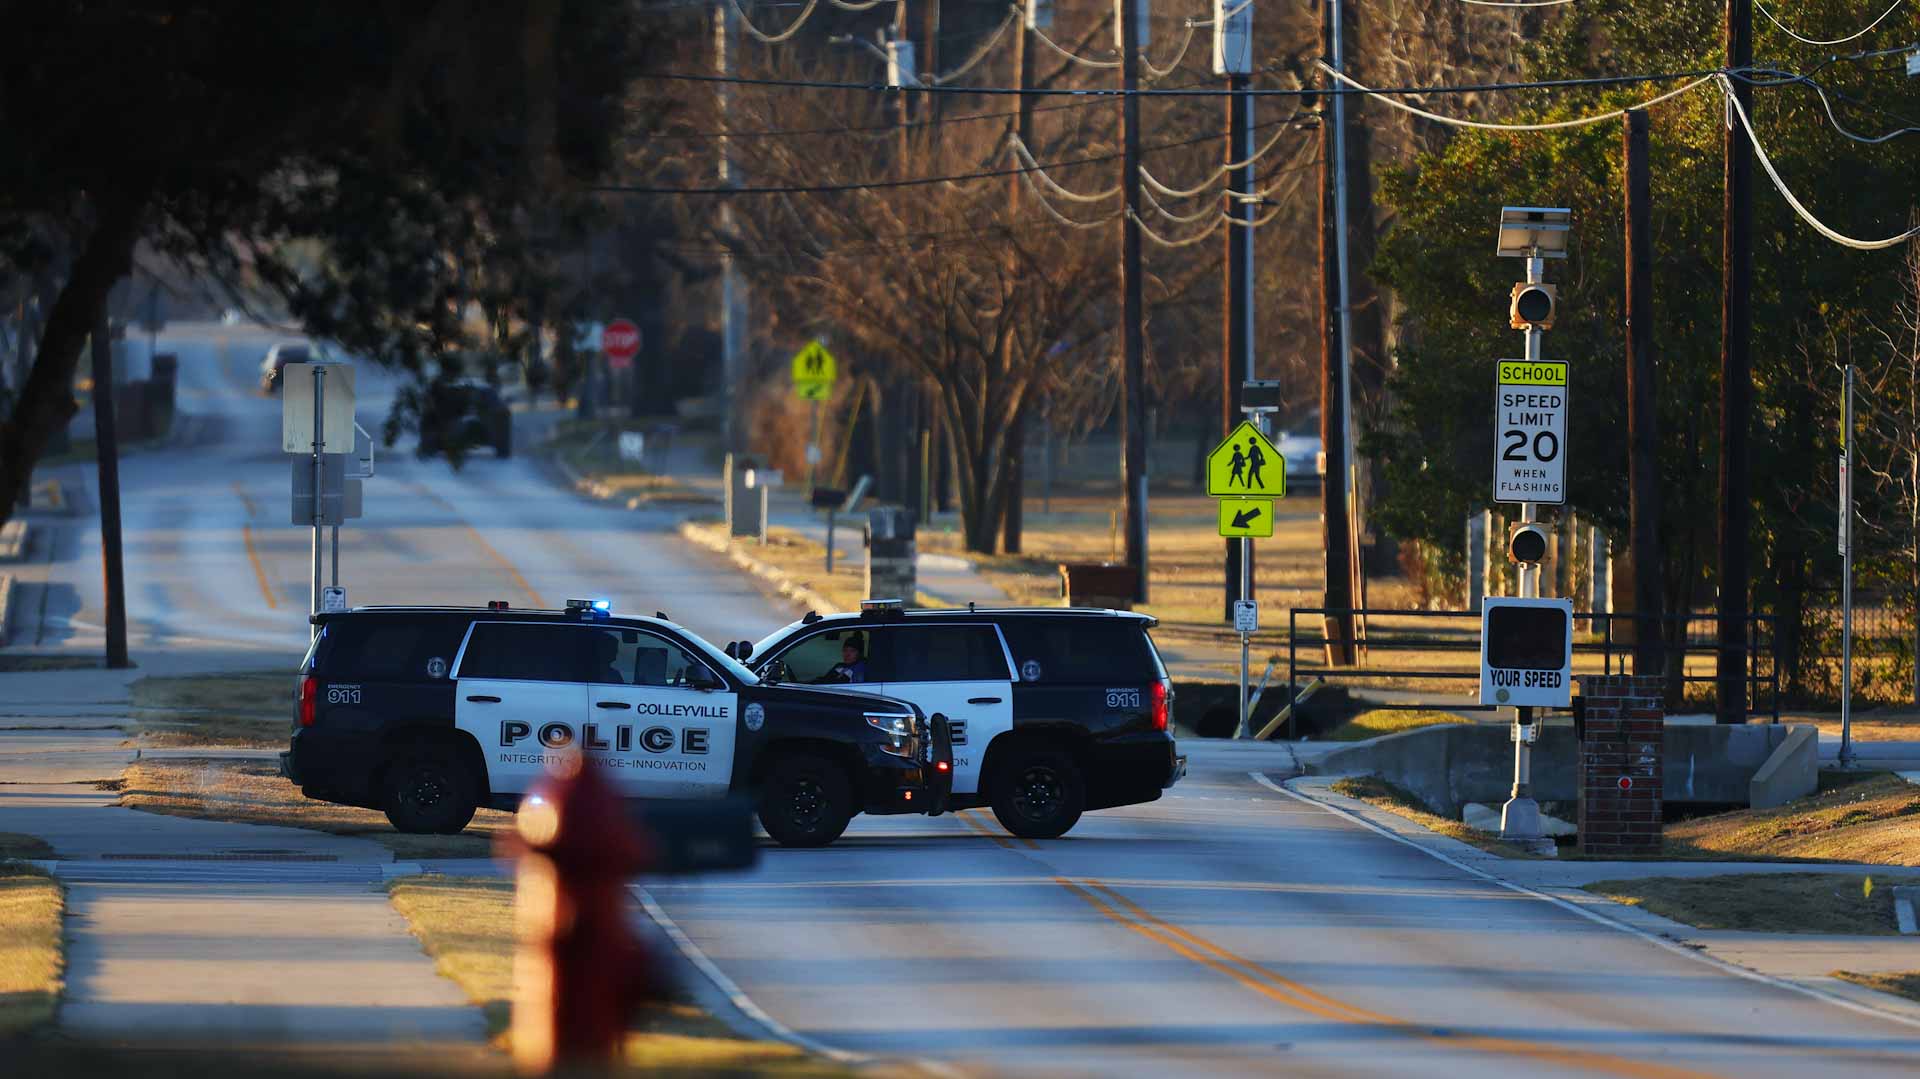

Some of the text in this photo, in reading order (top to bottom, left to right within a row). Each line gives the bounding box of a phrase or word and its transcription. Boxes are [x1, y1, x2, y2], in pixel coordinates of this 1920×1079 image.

[1502, 366, 1564, 381] SCHOOL
[1503, 394, 1561, 408] SPEED
[1508, 412, 1554, 426] LIMIT
[1502, 430, 1558, 462] 20
[1514, 469, 1546, 478] WHEN
[1501, 482, 1559, 492] FLASHING
[1490, 669, 1561, 688] YOUR SPEED
[327, 689, 361, 704] 911
[1106, 693, 1140, 707] 911
[637, 703, 728, 718] COLLEYVILLE
[499, 720, 710, 754] POLICE
